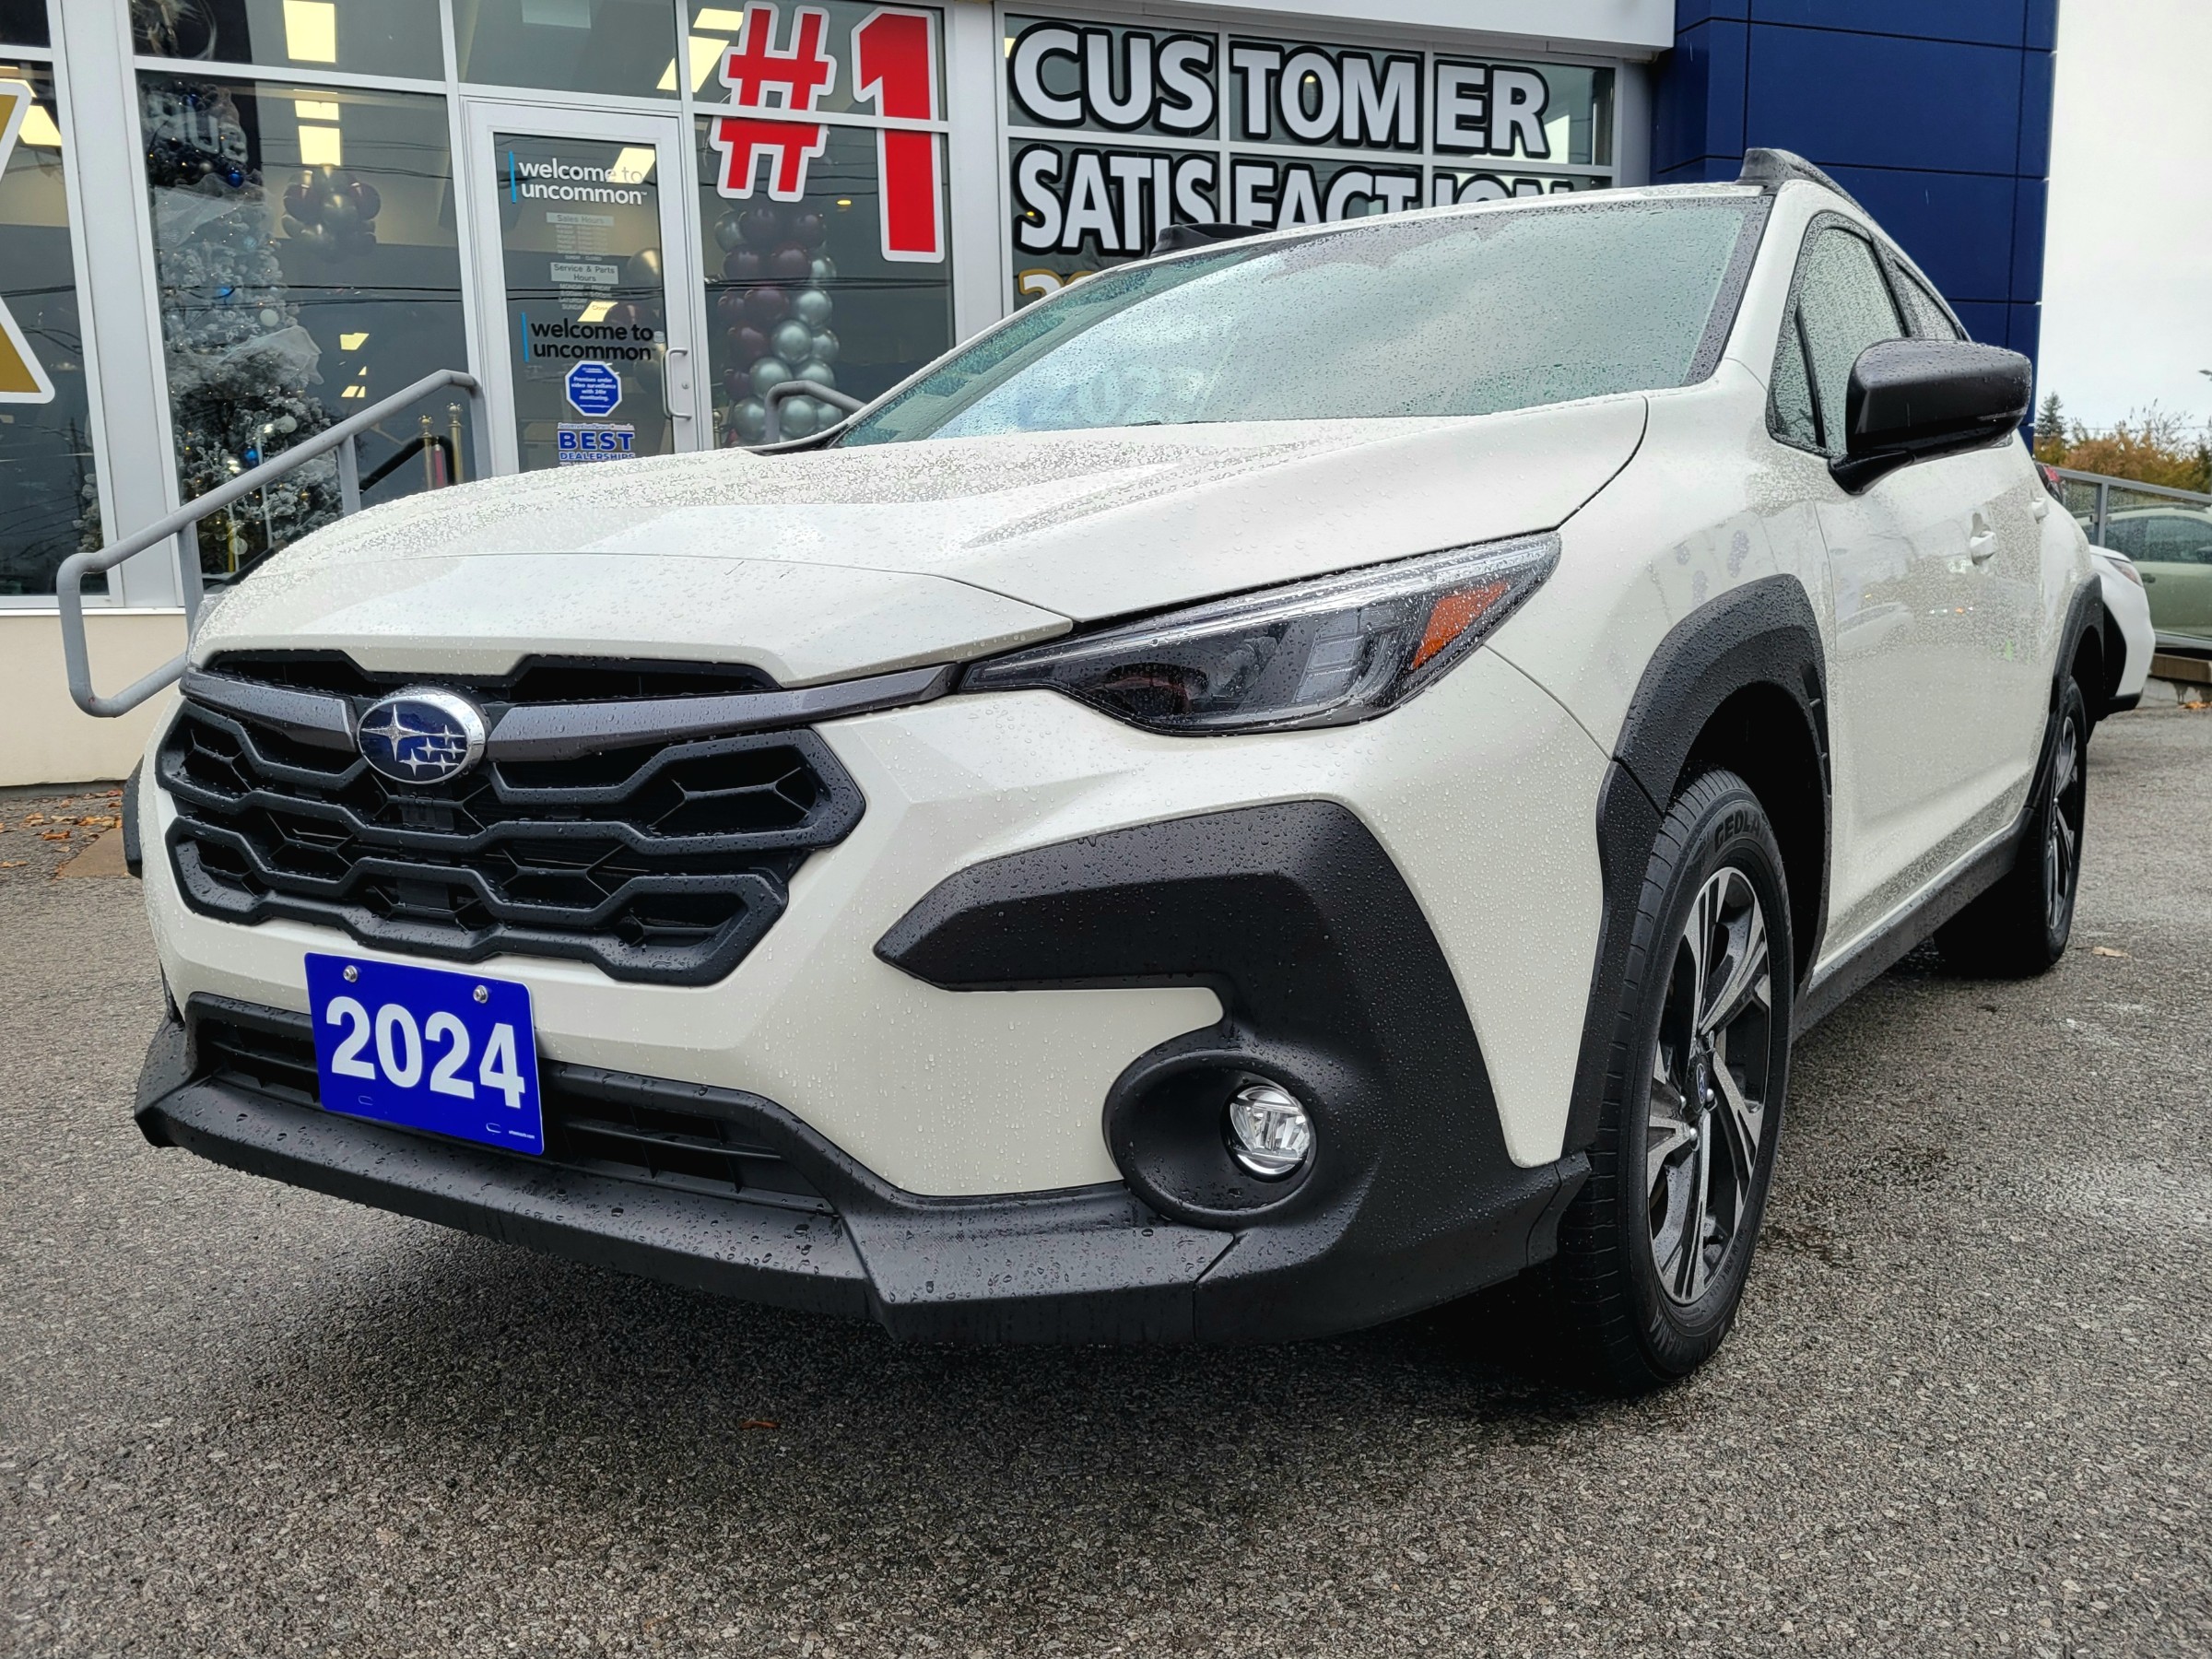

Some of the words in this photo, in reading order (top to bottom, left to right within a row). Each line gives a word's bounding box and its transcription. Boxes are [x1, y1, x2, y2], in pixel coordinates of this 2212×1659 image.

[1013, 22, 1550, 159] CUSTOMER
[710, 0, 945, 263] #1
[519, 158, 616, 182] welcome
[621, 167, 643, 182] to
[1015, 144, 1574, 255] SATISFAC
[554, 264, 583, 272] Service
[573, 274, 596, 282] Hours
[531, 318, 628, 340] welcome
[630, 324, 653, 341] to
[558, 430, 635, 452] BEST
[559, 452, 635, 462] DEALERSHIPS
[325, 995, 526, 1109] 2024
